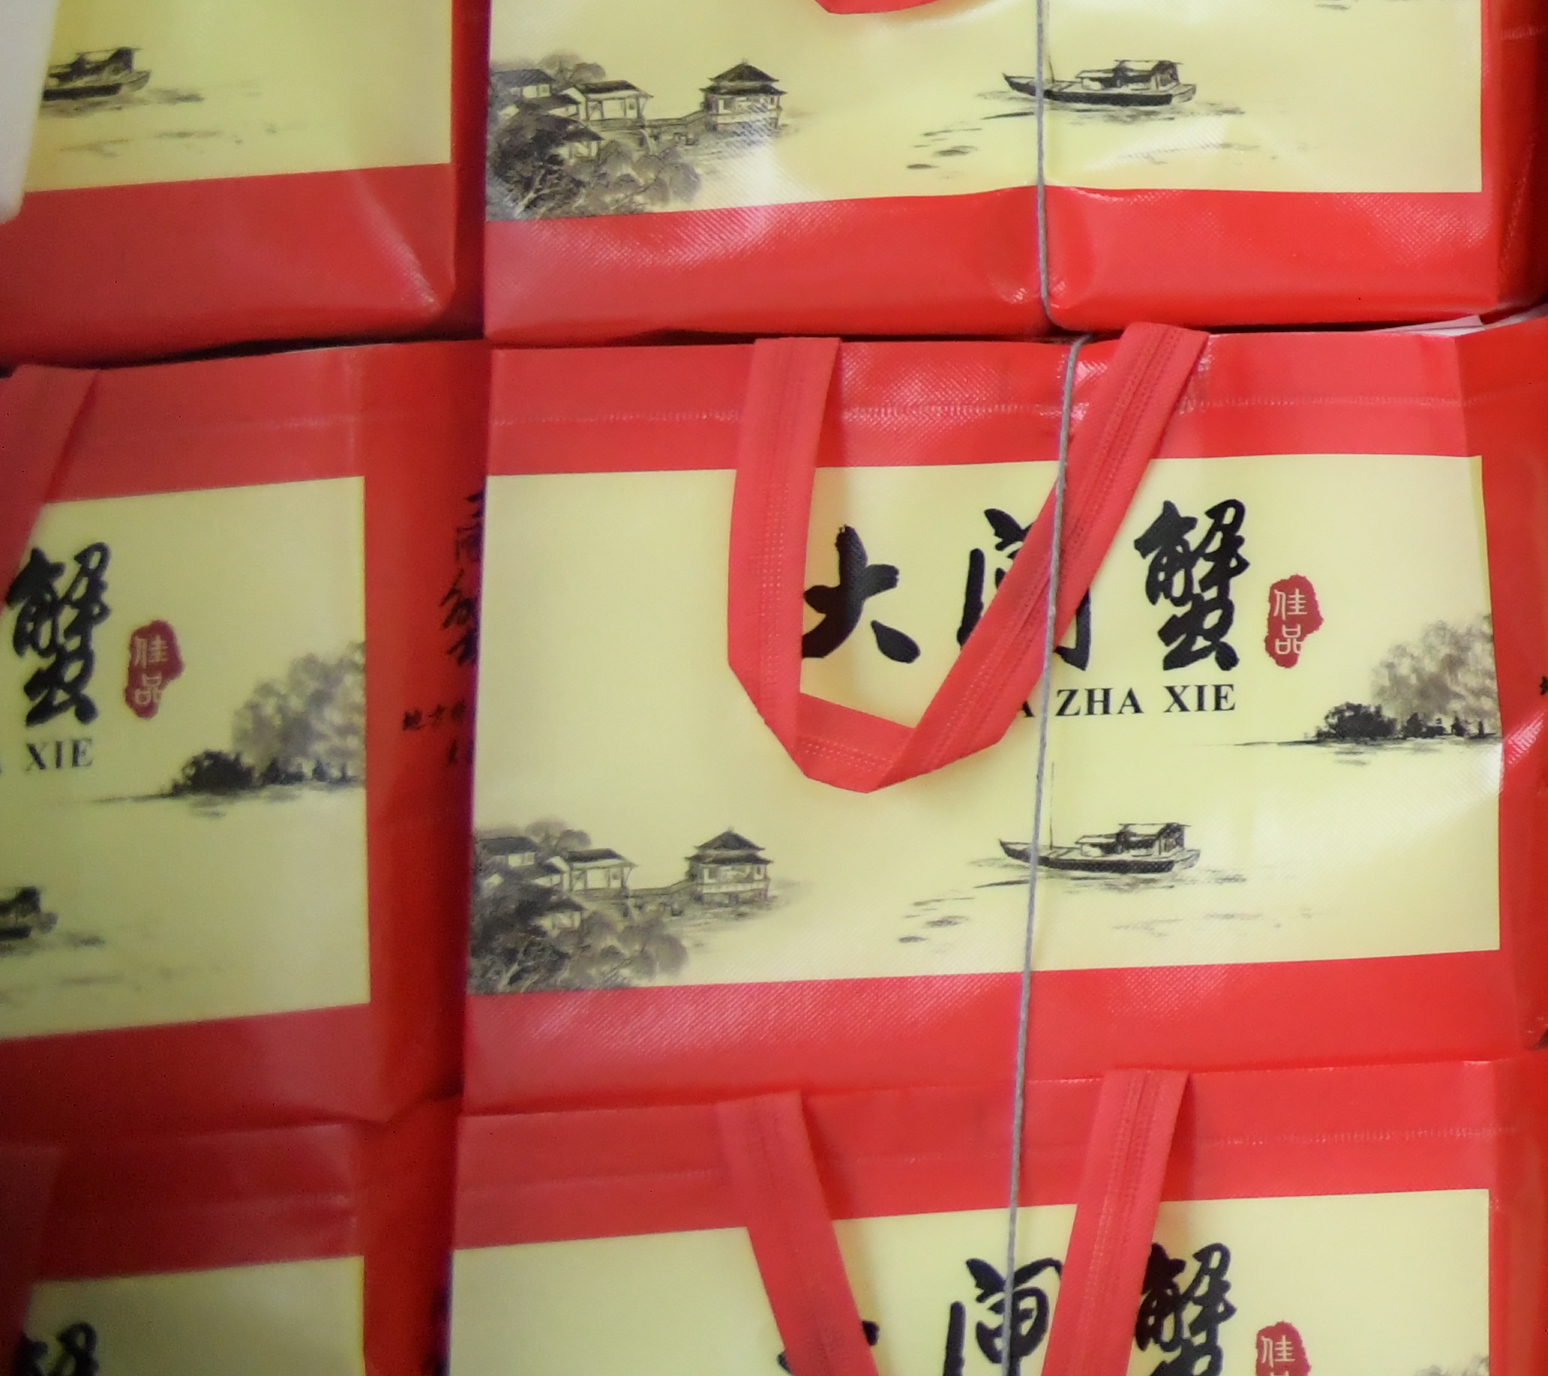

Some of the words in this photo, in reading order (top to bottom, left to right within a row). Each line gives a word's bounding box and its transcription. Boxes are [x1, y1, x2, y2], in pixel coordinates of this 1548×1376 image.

[1273, 590, 1307, 654] 佳品
[1056, 686, 1143, 717] ZHA
[1164, 682, 1237, 714] XIE
[25, 738, 94, 772] XIE
